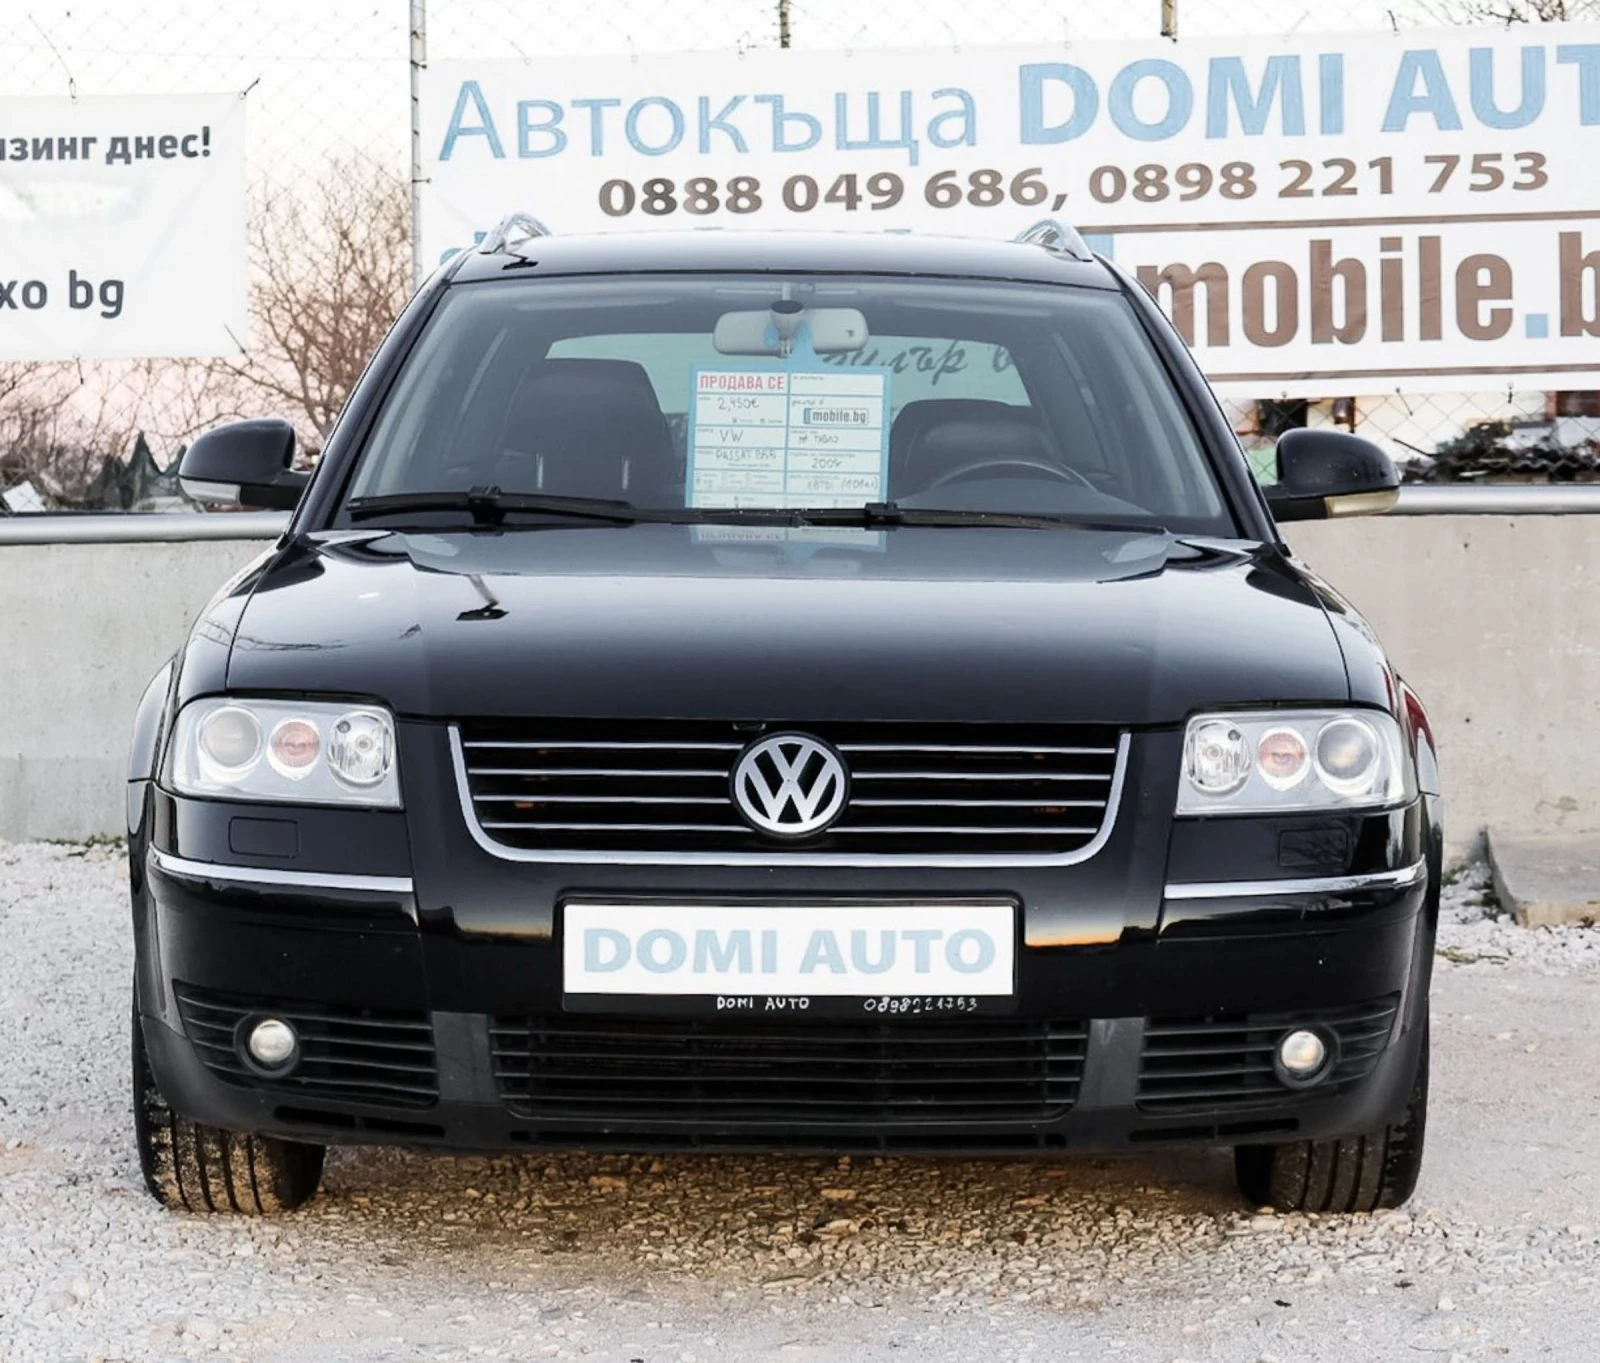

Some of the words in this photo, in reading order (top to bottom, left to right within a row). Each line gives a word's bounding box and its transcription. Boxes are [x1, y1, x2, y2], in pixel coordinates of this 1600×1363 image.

[439, 80, 977, 165] Автокъща
[1019, 54, 1343, 144] DOMI
[0, 137, 97, 162] зинг
[106, 126, 210, 165] днес!
[599, 176, 762, 217] 0888
[782, 172, 904, 212] 049
[924, 168, 1067, 211] 686,
[1089, 162, 1256, 203] 0898
[1278, 157, 1392, 198] 221
[1424, 152, 1548, 193] 753
[69, 269, 124, 319] bg
[700, 375, 763, 390] ПРОДАВА
[768, 376, 784, 390] СЕ
[719, 428, 744, 442] VW
[812, 410, 867, 423] mobile.bg
[735, 736, 845, 833] VW
[584, 928, 777, 974] DOMI
[798, 928, 996, 974] AUTO
[716, 996, 754, 1010] DOMI
[764, 996, 810, 1010] AUTO
